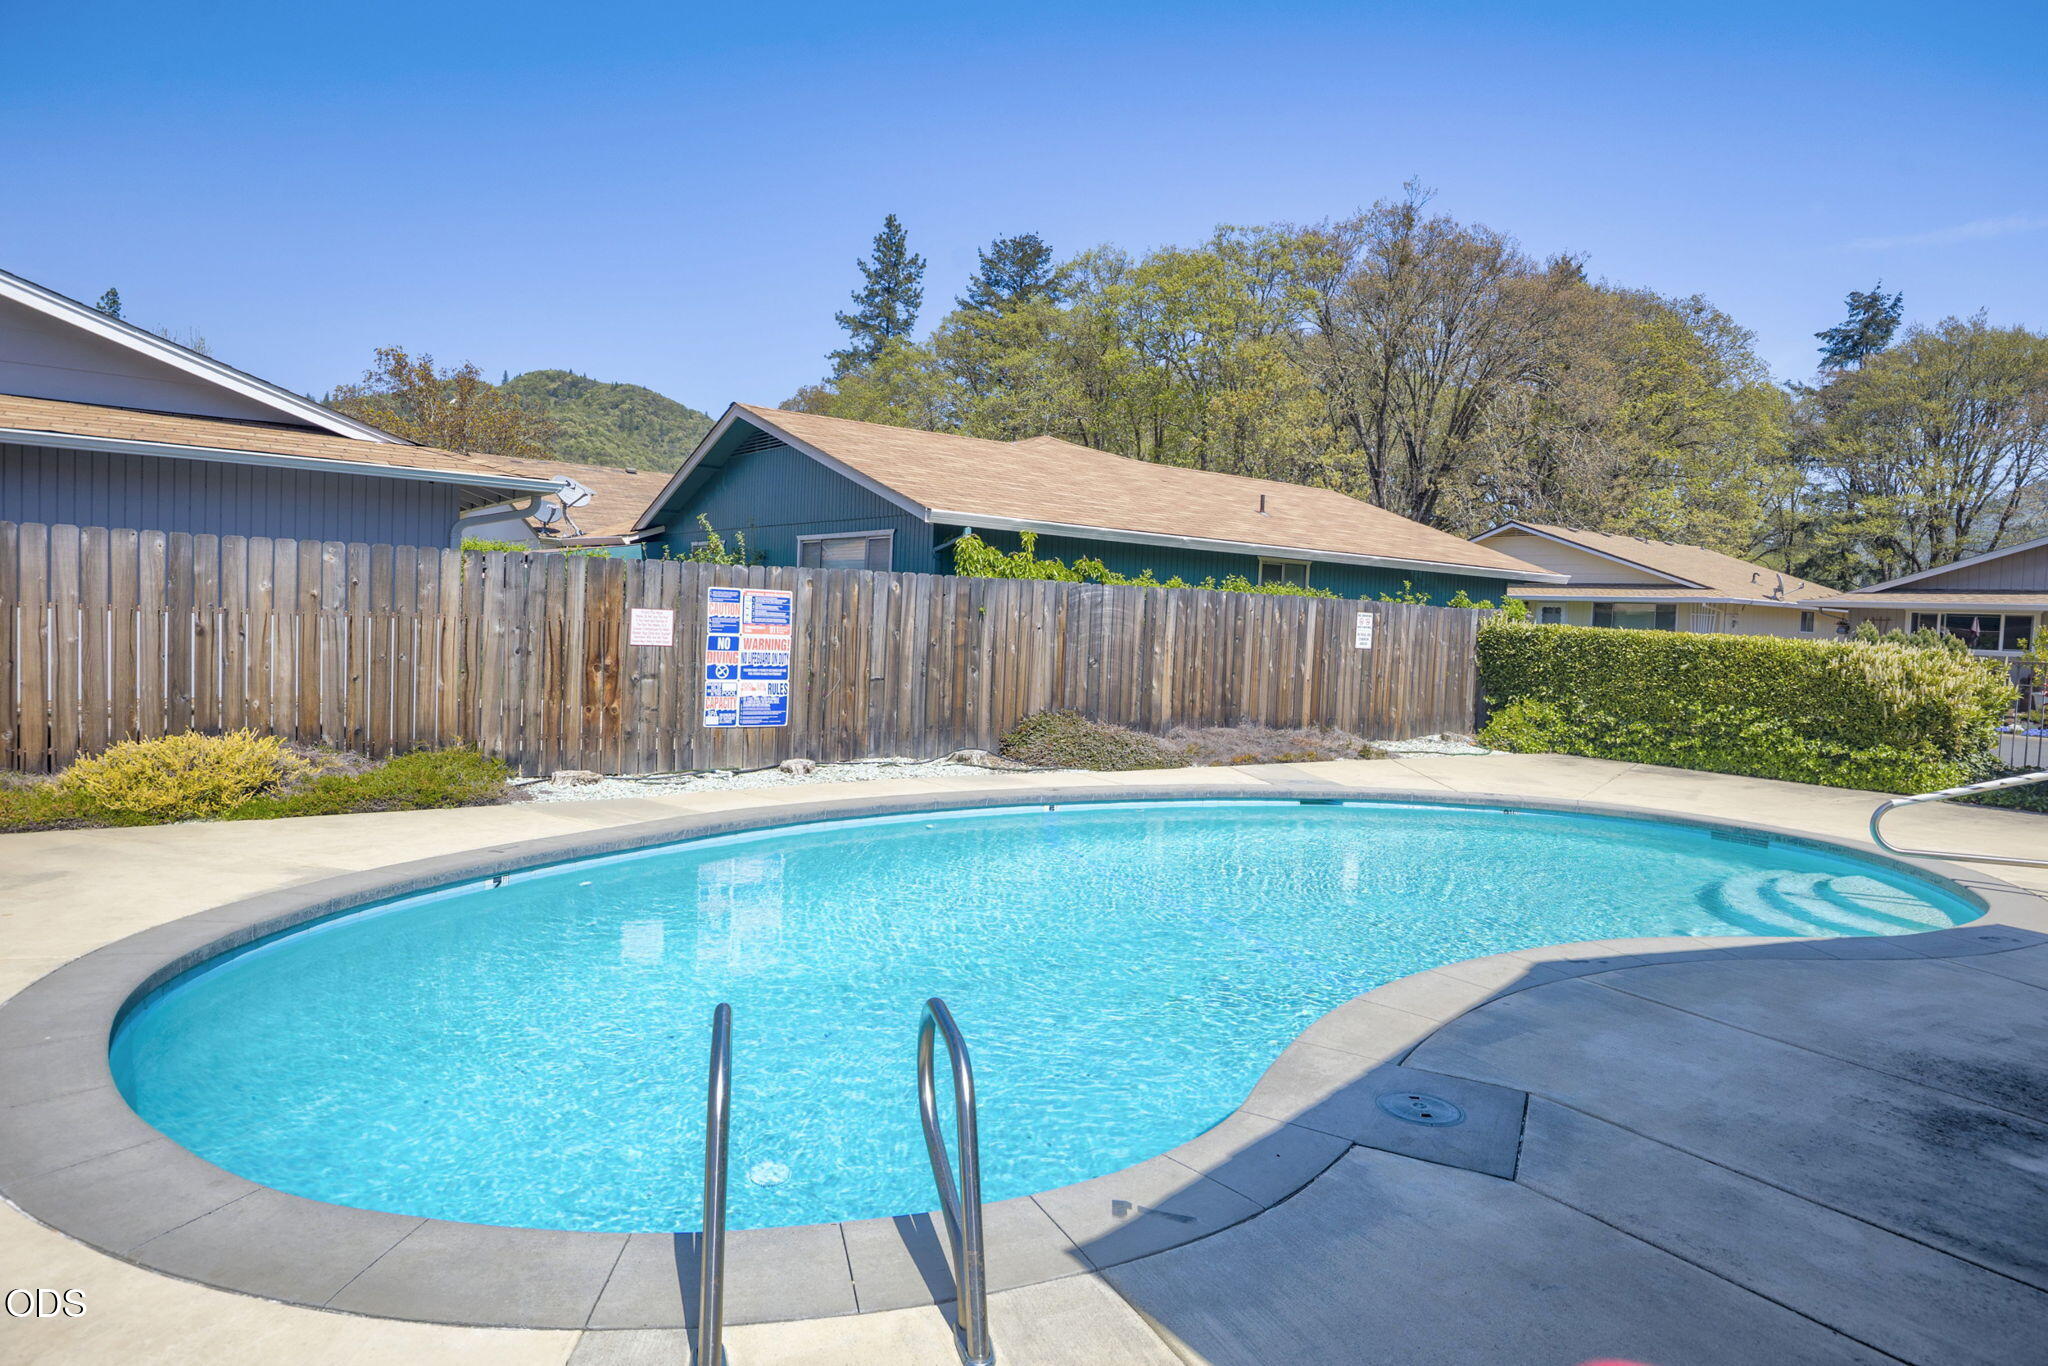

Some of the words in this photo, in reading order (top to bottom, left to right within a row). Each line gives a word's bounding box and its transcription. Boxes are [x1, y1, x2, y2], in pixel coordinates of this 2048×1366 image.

[709, 602, 740, 617] CAUTION
[717, 636, 731, 650] NO
[743, 638, 790, 651] WARNING!
[706, 651, 739, 664] DIVING
[741, 652, 747, 664] NO
[748, 652, 770, 665] LIFEGUARD
[772, 652, 778, 665] ON
[779, 653, 789, 665] DUTY
[768, 682, 788, 695] RULES
[706, 697, 737, 709] CAPACITY
